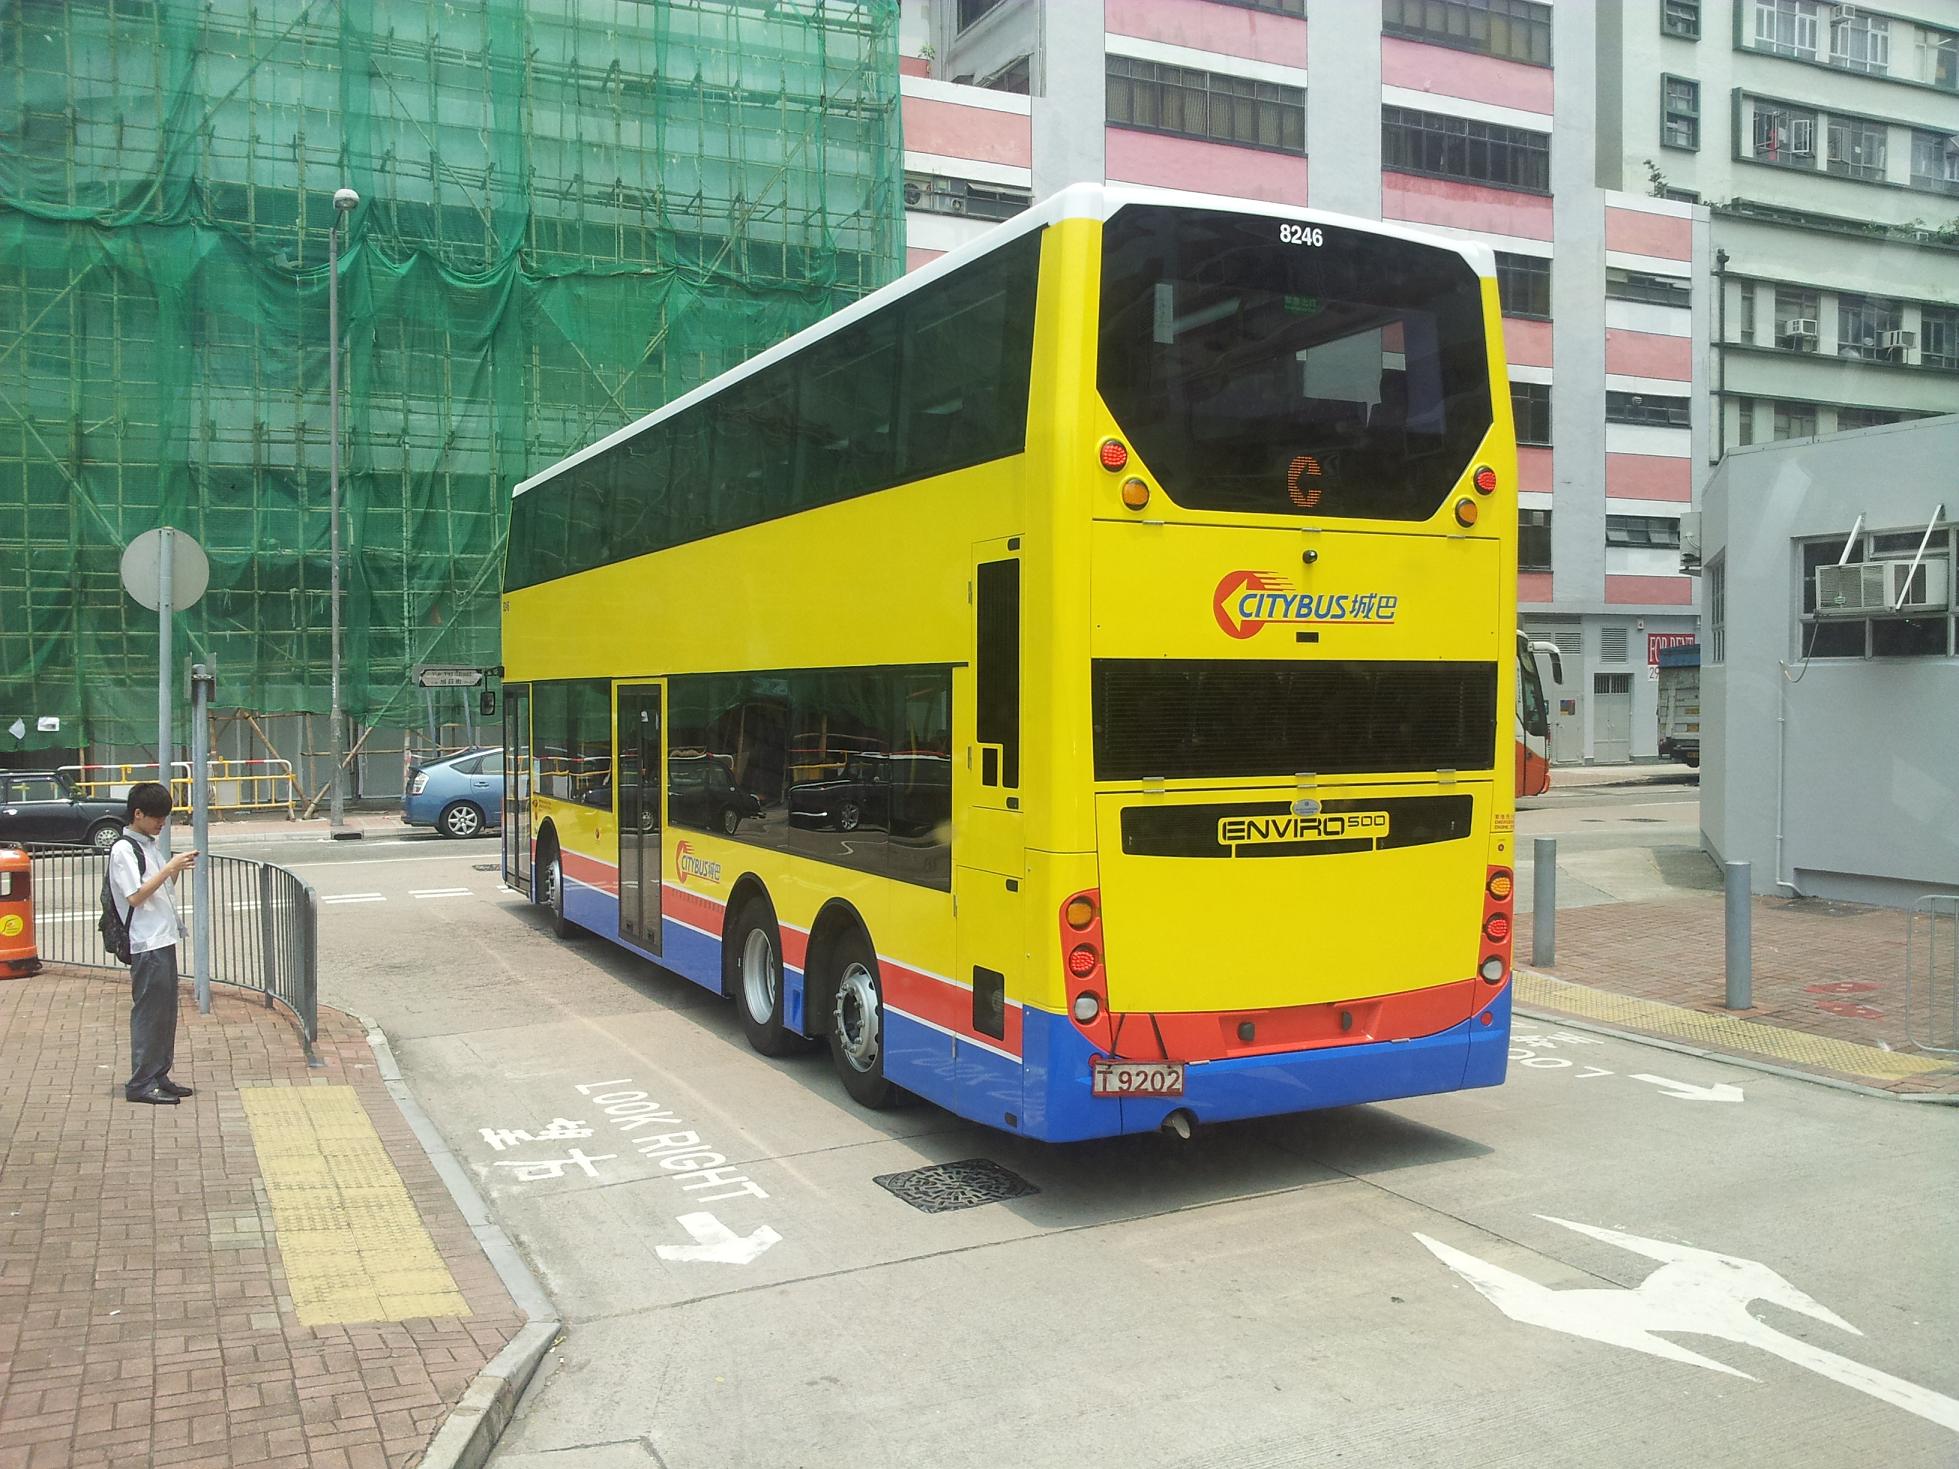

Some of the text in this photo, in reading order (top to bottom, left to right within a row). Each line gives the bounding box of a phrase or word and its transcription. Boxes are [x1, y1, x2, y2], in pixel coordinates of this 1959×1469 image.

[1279, 223, 1324, 248] 8246
[1238, 592, 1398, 620] CITYBUS 城巴
[574, 1078, 771, 1203] LOOK RIGHT
